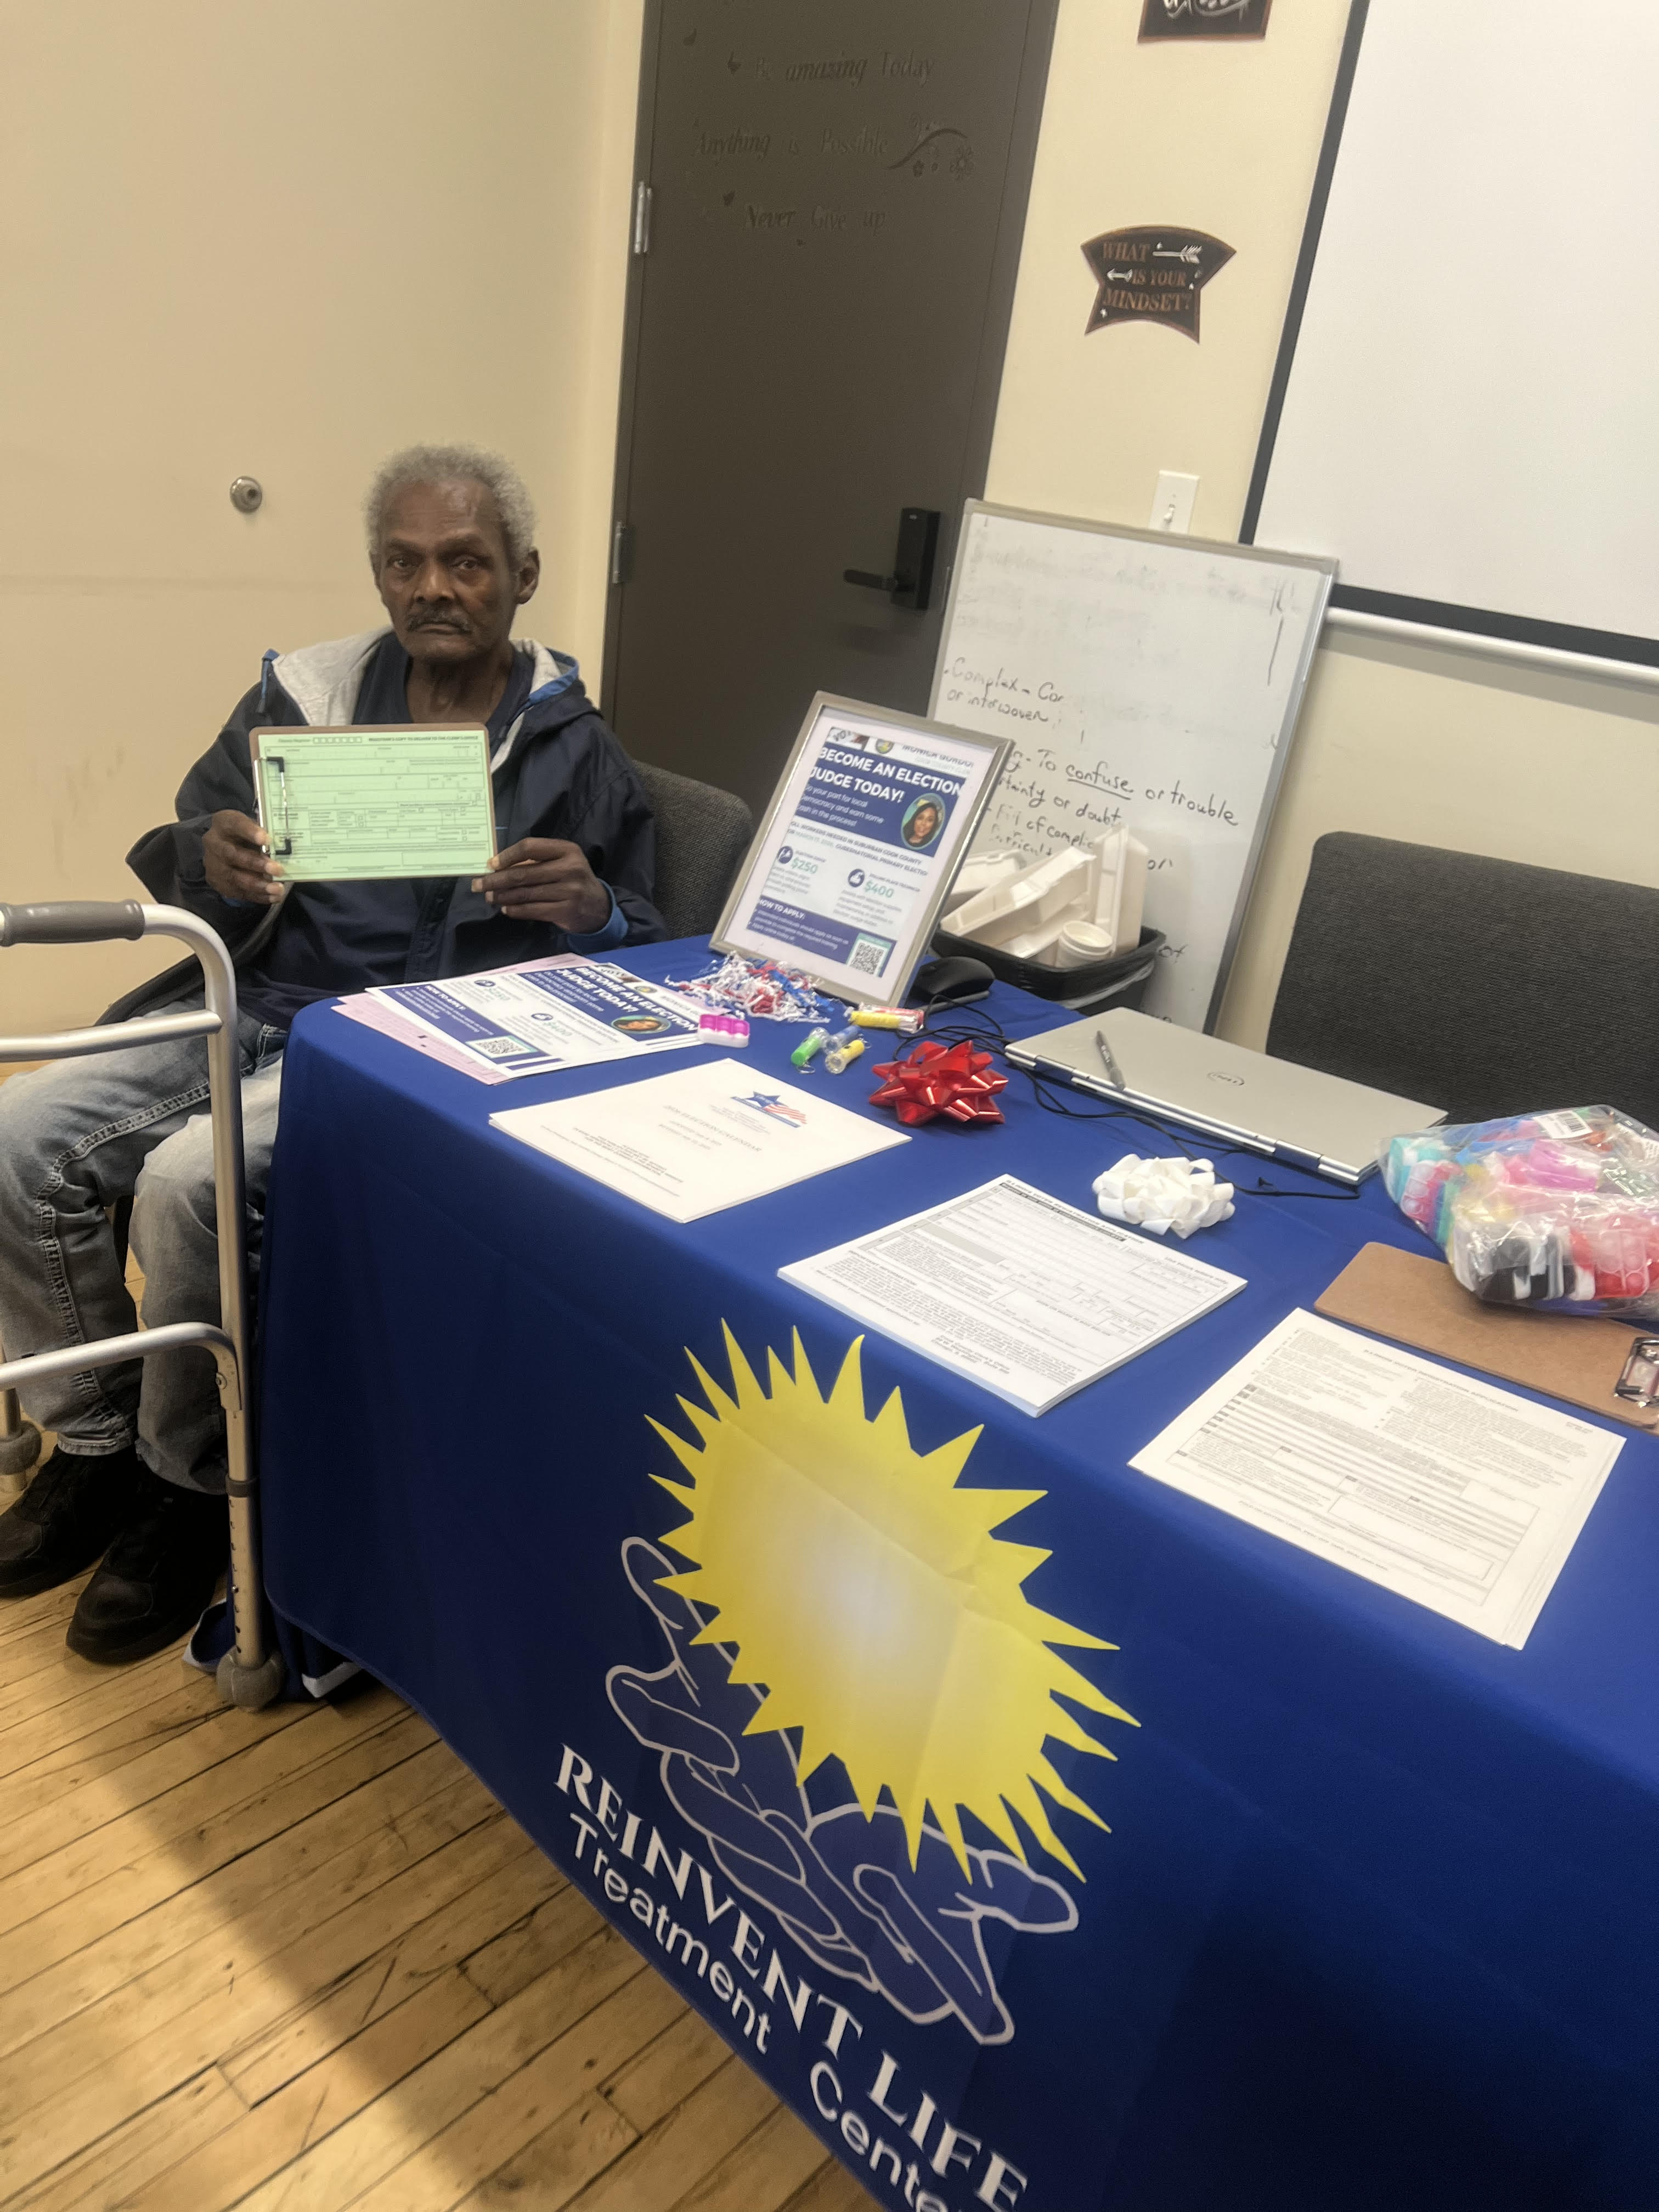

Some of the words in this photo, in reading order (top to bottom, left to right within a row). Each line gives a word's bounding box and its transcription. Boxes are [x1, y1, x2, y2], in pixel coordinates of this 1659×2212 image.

[785, 51, 868, 87] amazing
[882, 49, 934, 87] Today
[693, 126, 771, 167] Anything
[821, 124, 888, 156] Possible
[744, 202, 796, 229] Never
[811, 205, 847, 230] Give
[864, 209, 885, 235] up
[1103, 242, 1150, 262] WHAT
[1132, 268, 1146, 285] IS
[1150, 269, 1186, 286] YOUR
[1103, 287, 1193, 312] MINDSET?
[947, 689, 963, 701] or
[808, 765, 855, 788] JUDGE
[850, 777, 906, 803] TODAY!
[817, 747, 875, 772] BECOME
[871, 760, 897, 778] AN
[893, 767, 965, 797] ELECTION
[811, 787, 827, 797] your
[840, 794, 851, 803] for
[1038, 749, 1056, 771] To
[1066, 760, 1133, 793] confuse
[1146, 789, 1164, 800] or
[1171, 780, 1238, 826] trouble
[817, 810, 831, 819] the
[834, 804, 849, 813] and
[1053, 796, 1069, 809] or
[1076, 803, 1120, 826] doubt
[789, 856, 820, 876] $250
[898, 854, 922, 865] COUNTY
[863, 879, 896, 900] $400
[774, 904, 783, 912] TO
[624, 991, 644, 1002] AN
[639, 1000, 698, 1032] ELECTION
[555, 1743, 864, 2060] REINVENT
[867, 2049, 1028, 2212] LIFE
[569, 1813, 771, 2053] Treatment
[810, 2061, 960, 2212] Cente
